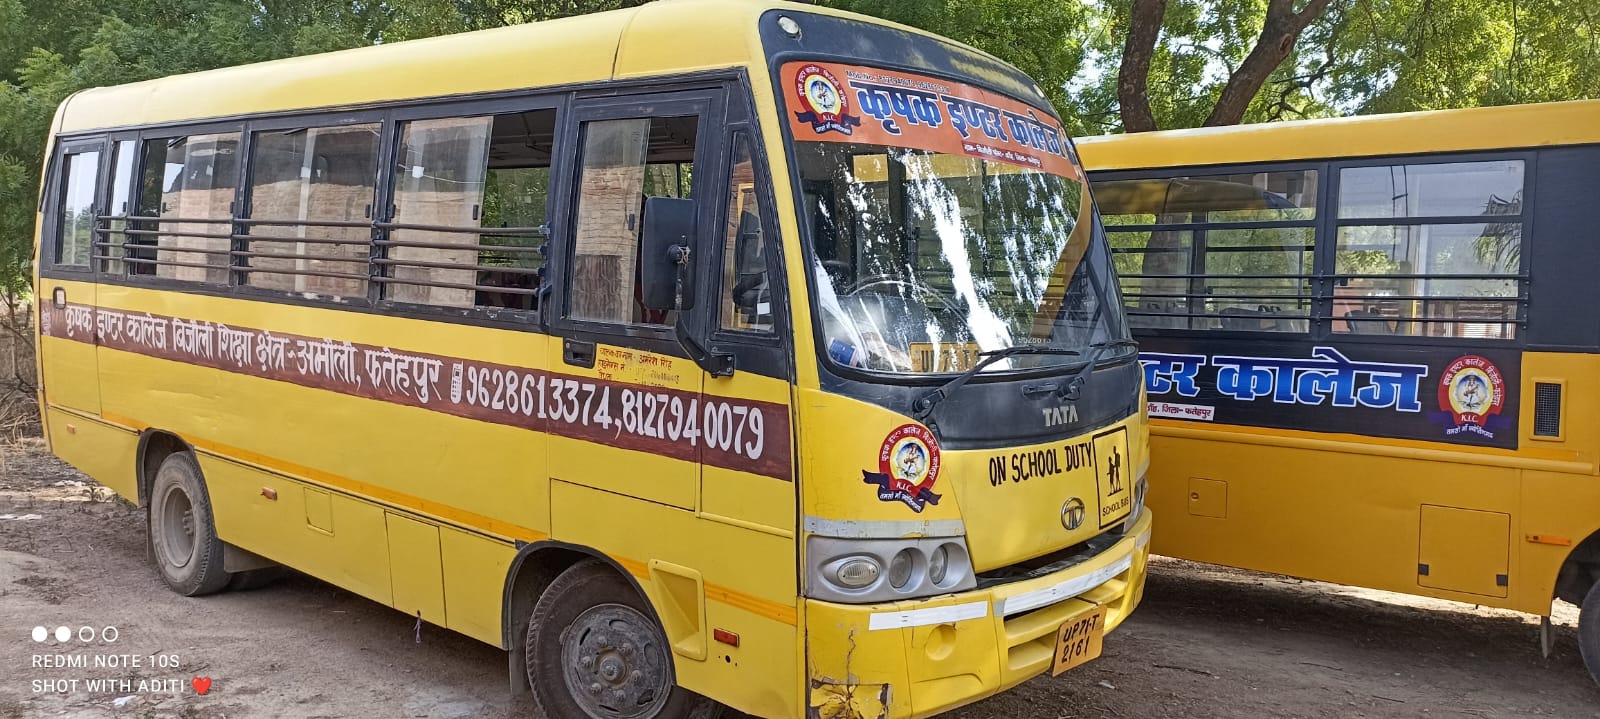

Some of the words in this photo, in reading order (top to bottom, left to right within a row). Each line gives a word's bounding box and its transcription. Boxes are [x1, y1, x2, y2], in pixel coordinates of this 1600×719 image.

[848, 80, 942, 135] कृषक
[942, 96, 1008, 141] इण्टर
[65, 304, 93, 337] कृषक
[96, 309, 125, 344] इण्टर
[126, 312, 168, 351] कालेज
[217, 323, 255, 367] शिक्षा
[364, 347, 444, 404] फतेहपुर
[1139, 352, 1206, 397] टर
[1211, 346, 1428, 412] कालेज
[1042, 405, 1078, 427] TATA
[989, 455, 1007, 487] ON
[1011, 448, 1062, 483] SCHOOL
[1065, 442, 1093, 472] DUTY
[1102, 502, 1121, 517] SCHOOL
[1121, 496, 1130, 508] BUS
[1061, 635, 1090, 664] 2161
